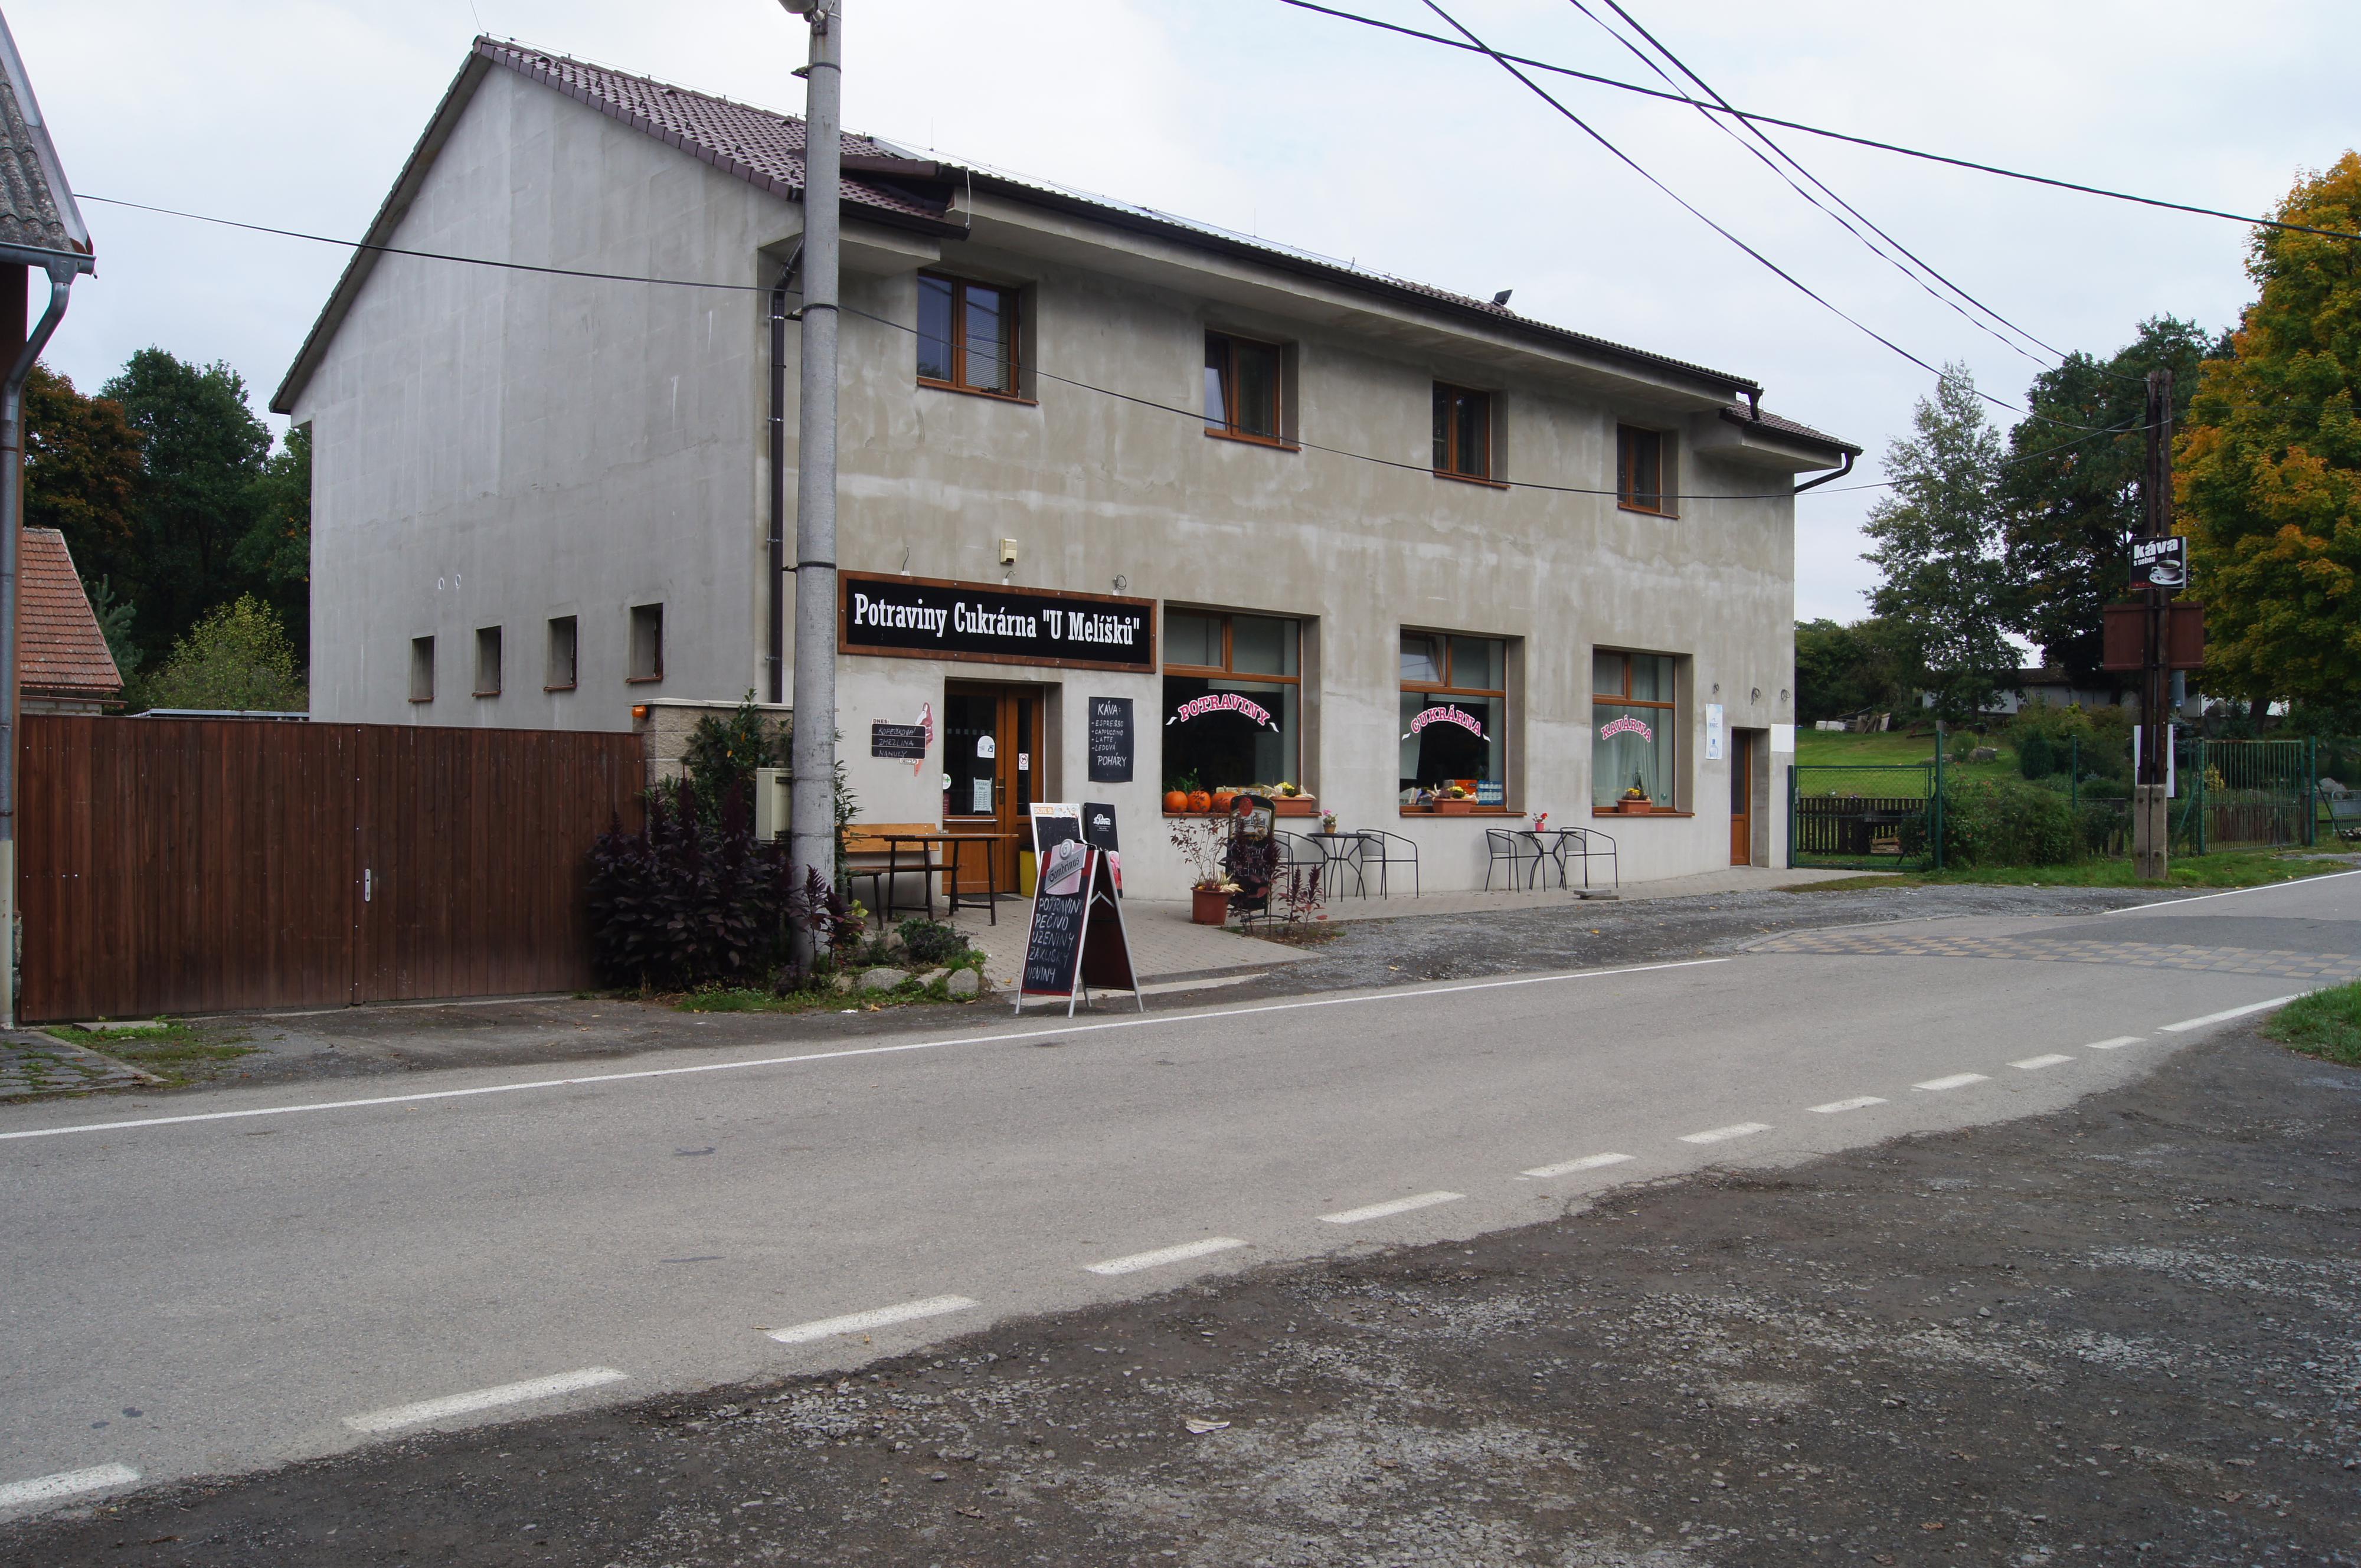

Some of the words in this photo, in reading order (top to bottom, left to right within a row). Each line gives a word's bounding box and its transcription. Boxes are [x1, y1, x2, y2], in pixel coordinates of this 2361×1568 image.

[2134, 539, 2179, 559] káva
[2138, 556, 2156, 565] sobou
[855, 593, 947, 637] Potraviny
[954, 602, 1037, 637] Cukrárna
[1178, 693, 1270, 726] POTRAVINY
[1411, 704, 1481, 737] CUKRÁRNA
[1600, 714, 1652, 742] KAVÁRNA
[1097, 752, 1127, 767] POHÁRY
[1048, 857, 1080, 883] Gambrinus
[1035, 912, 1069, 931] PEČIVO
[1026, 965, 1056, 984] NOVINY
